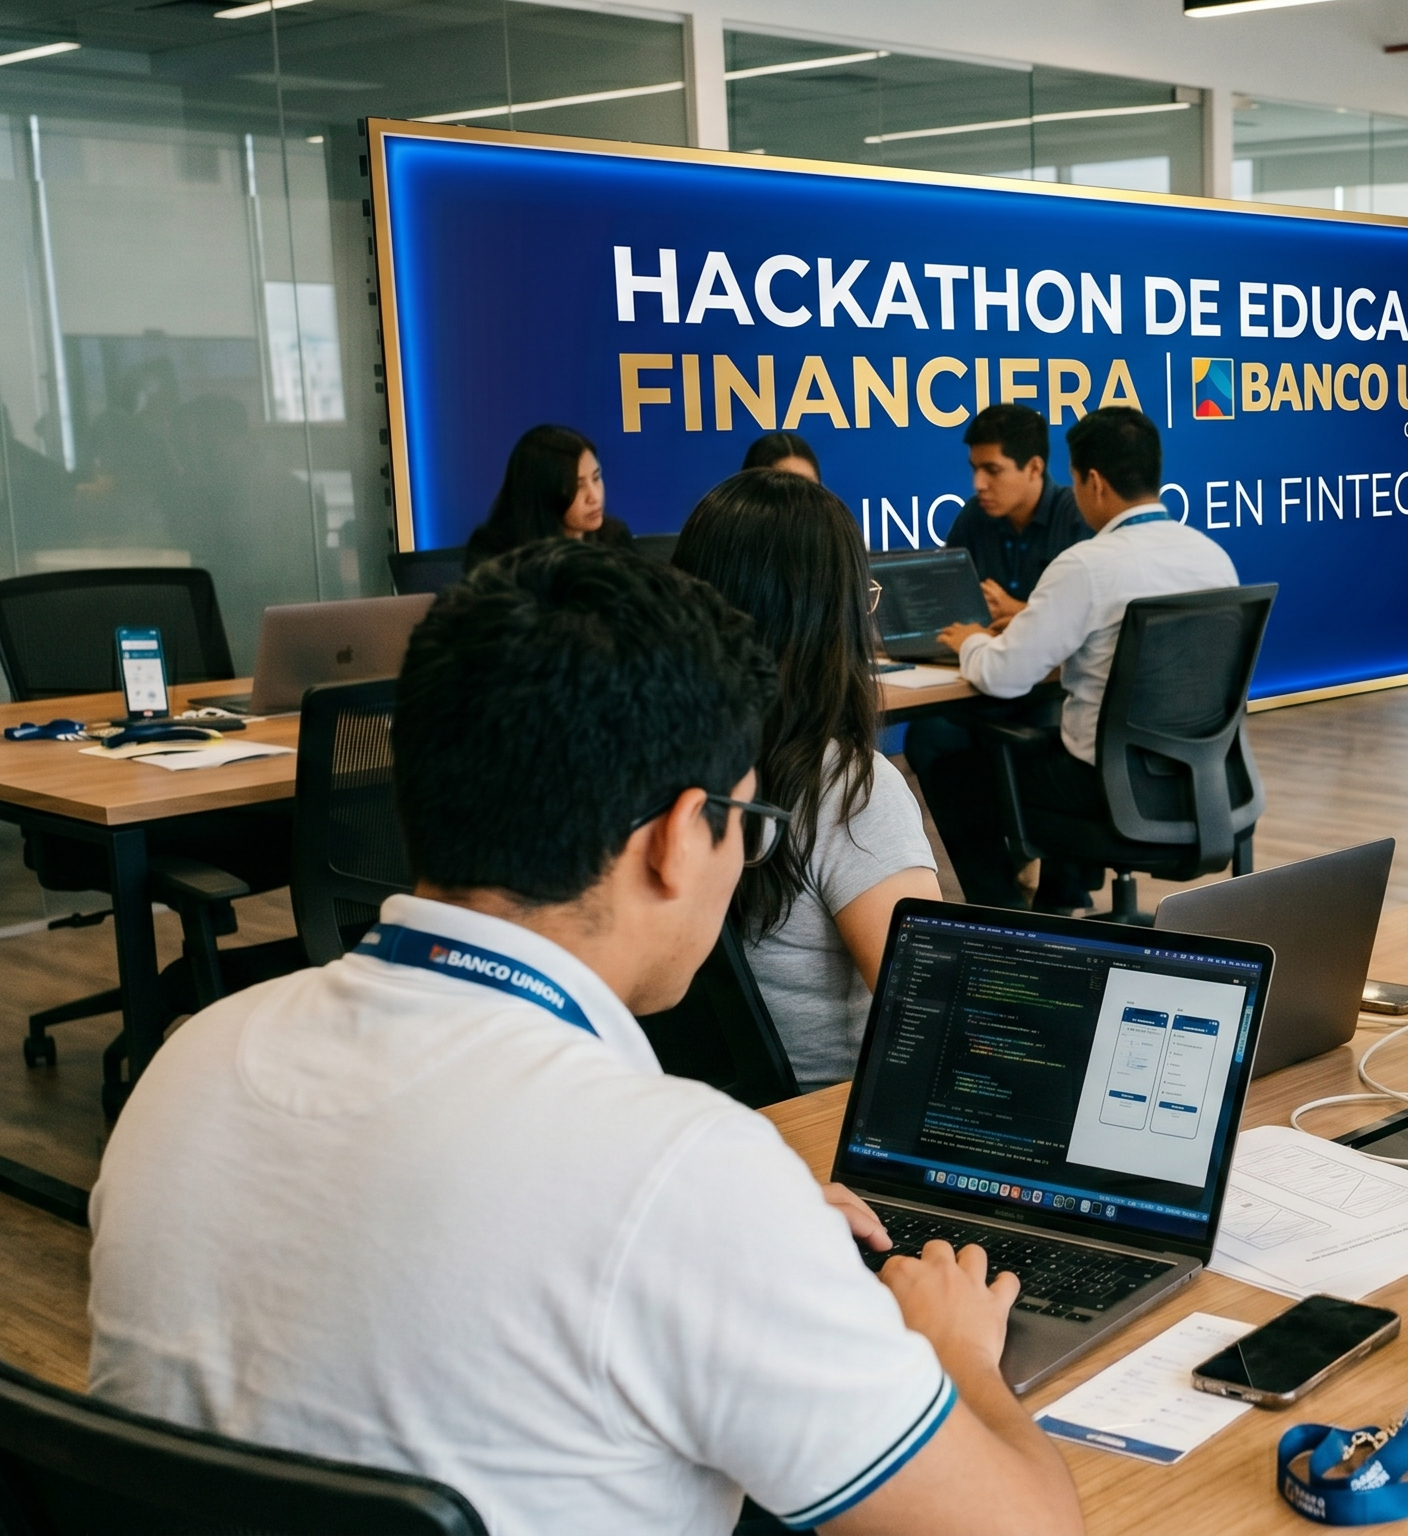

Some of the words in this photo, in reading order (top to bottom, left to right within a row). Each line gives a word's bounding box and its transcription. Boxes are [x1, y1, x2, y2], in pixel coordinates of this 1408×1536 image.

[613, 245, 1122, 335] HACKATHON
[1144, 275, 1222, 337] DE
[619, 352, 1143, 433] FINANCIERA
[1241, 362, 1389, 412] BANCO
[1206, 479, 1263, 529] EN
[447, 949, 512, 981] BANCO
[510, 970, 566, 1010] UNION
